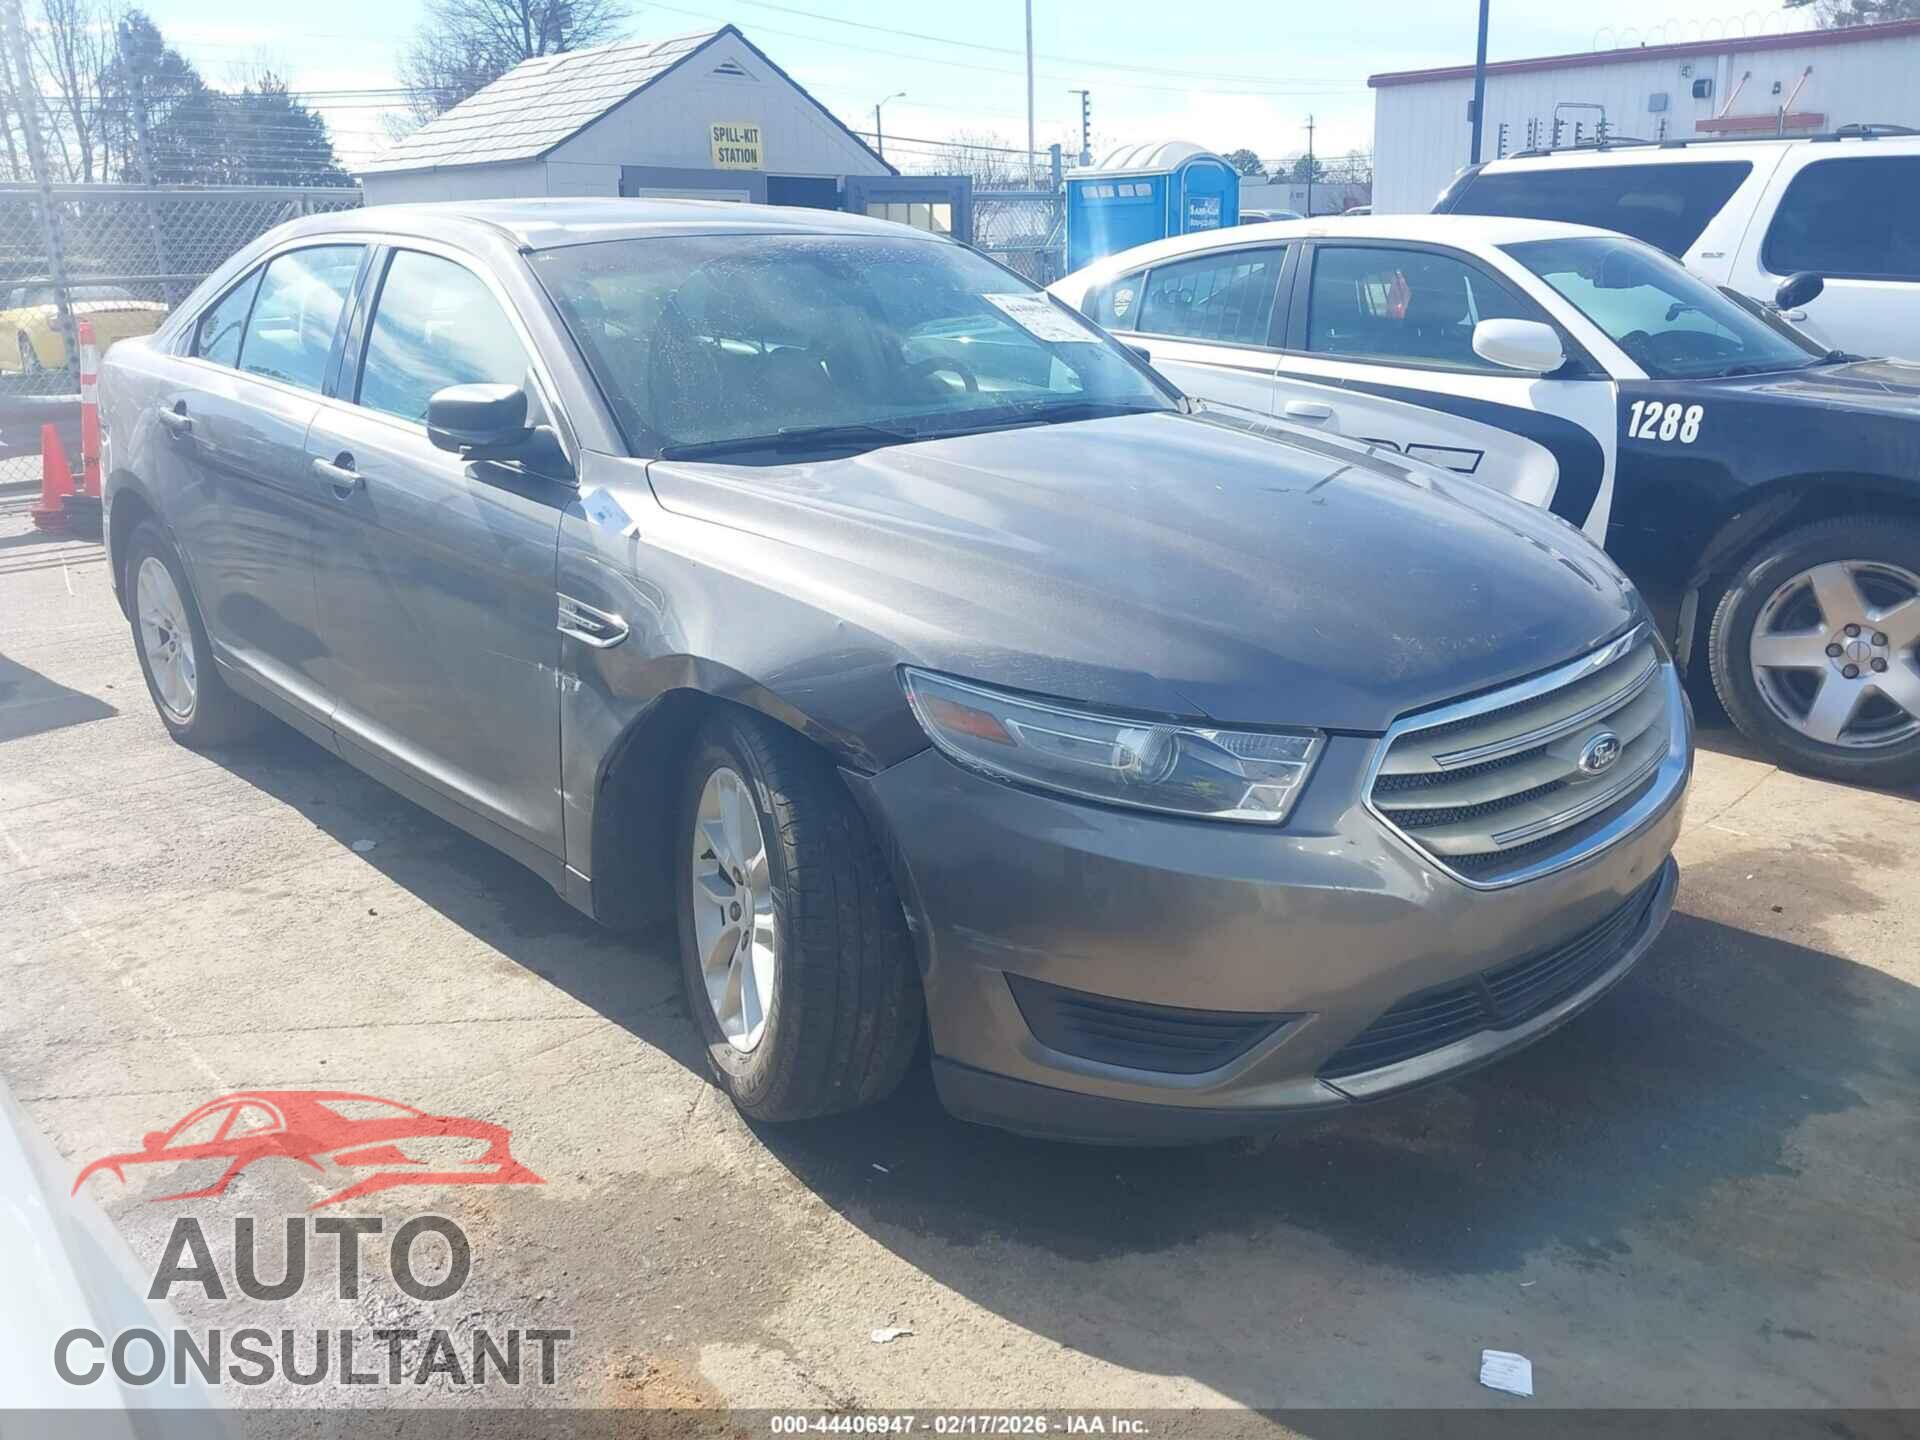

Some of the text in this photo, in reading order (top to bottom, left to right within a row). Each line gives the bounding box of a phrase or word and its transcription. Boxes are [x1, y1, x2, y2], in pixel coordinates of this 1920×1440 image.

[713, 127, 758, 143] SPILL-KIT
[718, 147, 757, 163] STATION
[1628, 400, 1704, 444] 1288
